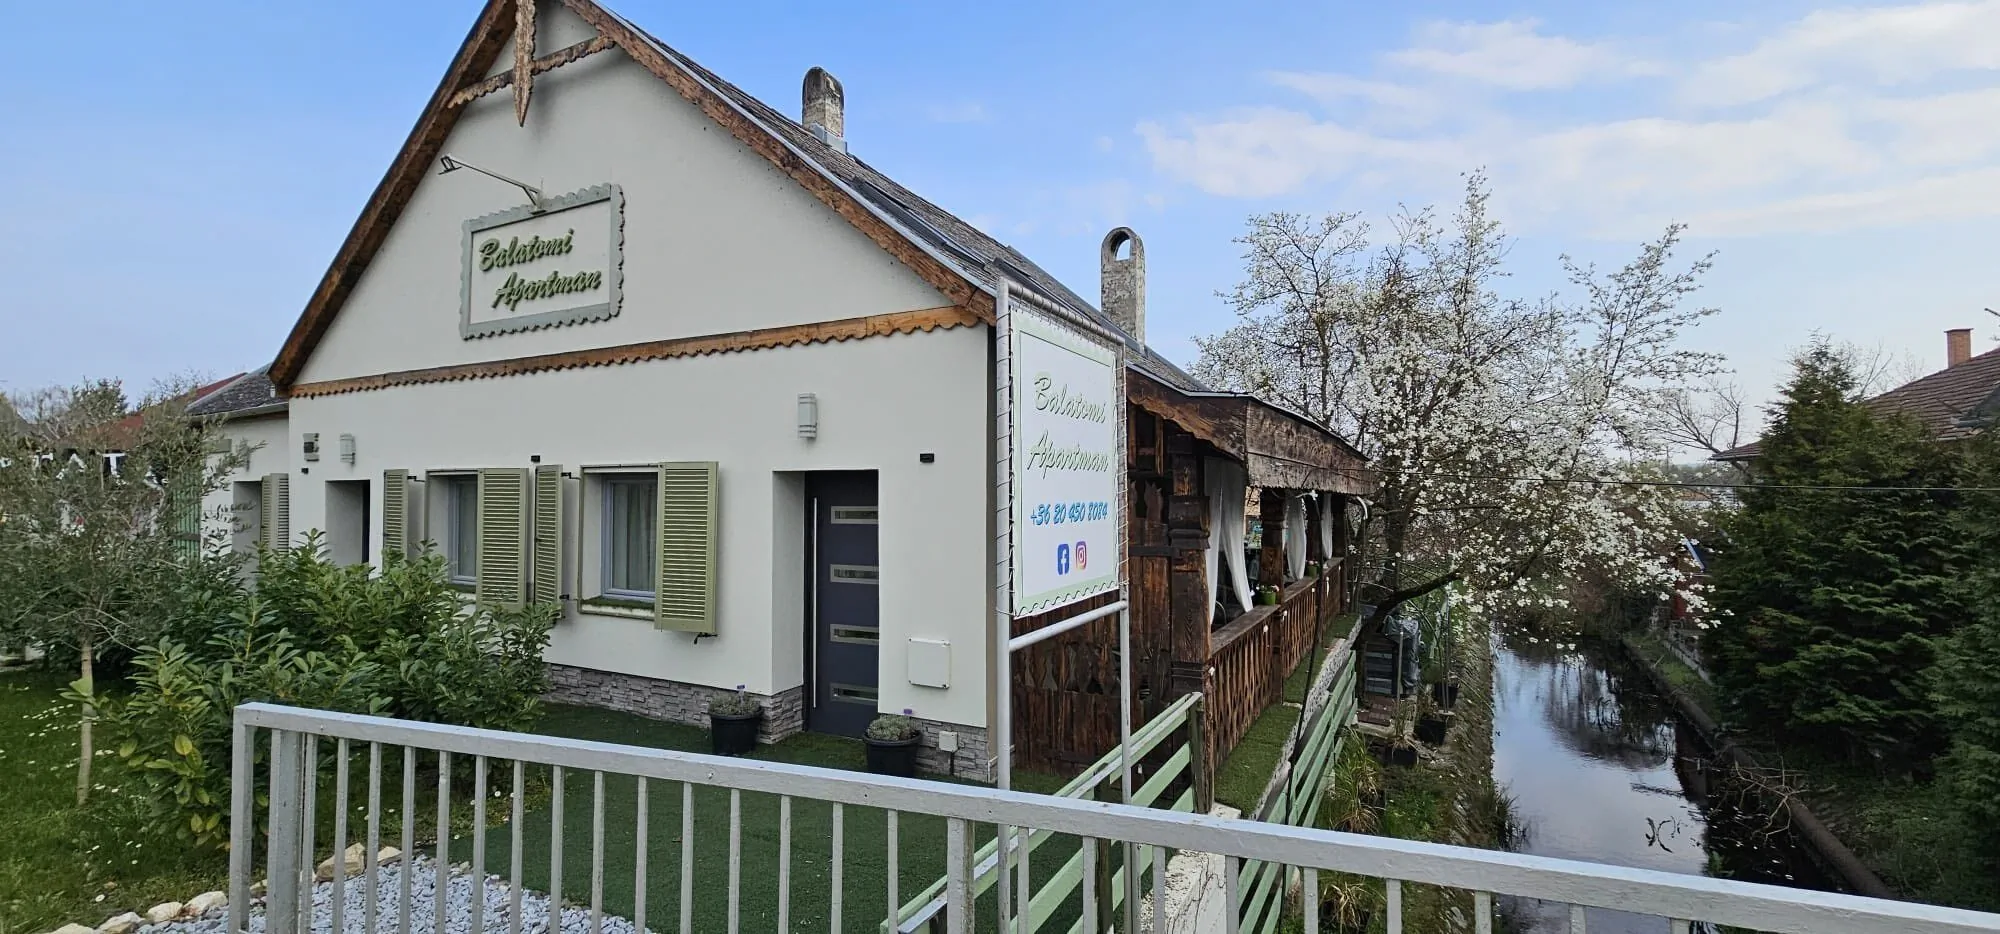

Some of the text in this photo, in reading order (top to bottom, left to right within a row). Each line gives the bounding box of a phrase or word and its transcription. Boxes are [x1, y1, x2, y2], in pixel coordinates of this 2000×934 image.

[479, 228, 574, 271] Balatomi
[491, 270, 602, 312] Apartman
[1033, 372, 1107, 424] Balatomi
[1026, 426, 1109, 480] Apartman
[1030, 501, 1108, 526] +36 20 450 8084
